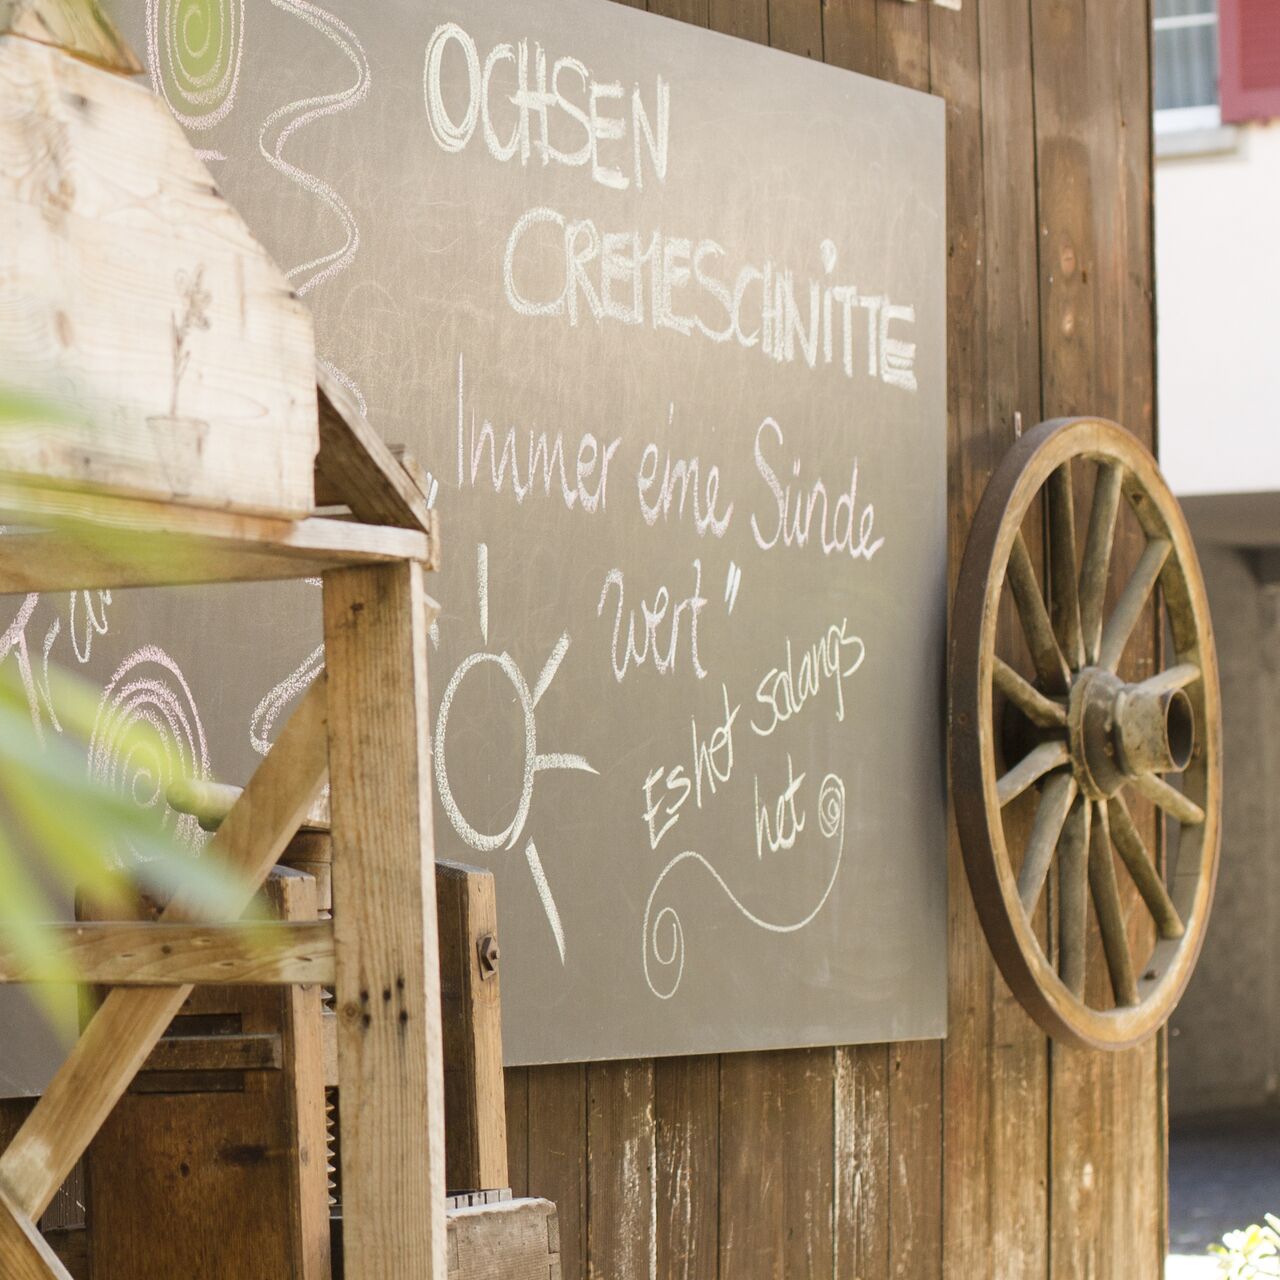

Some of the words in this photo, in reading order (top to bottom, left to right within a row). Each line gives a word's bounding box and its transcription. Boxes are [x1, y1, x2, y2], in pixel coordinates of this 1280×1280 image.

[423, 22, 670, 192] OCHSEN
[638, 401, 734, 538] eine
[750, 417, 885, 560] Sünde
